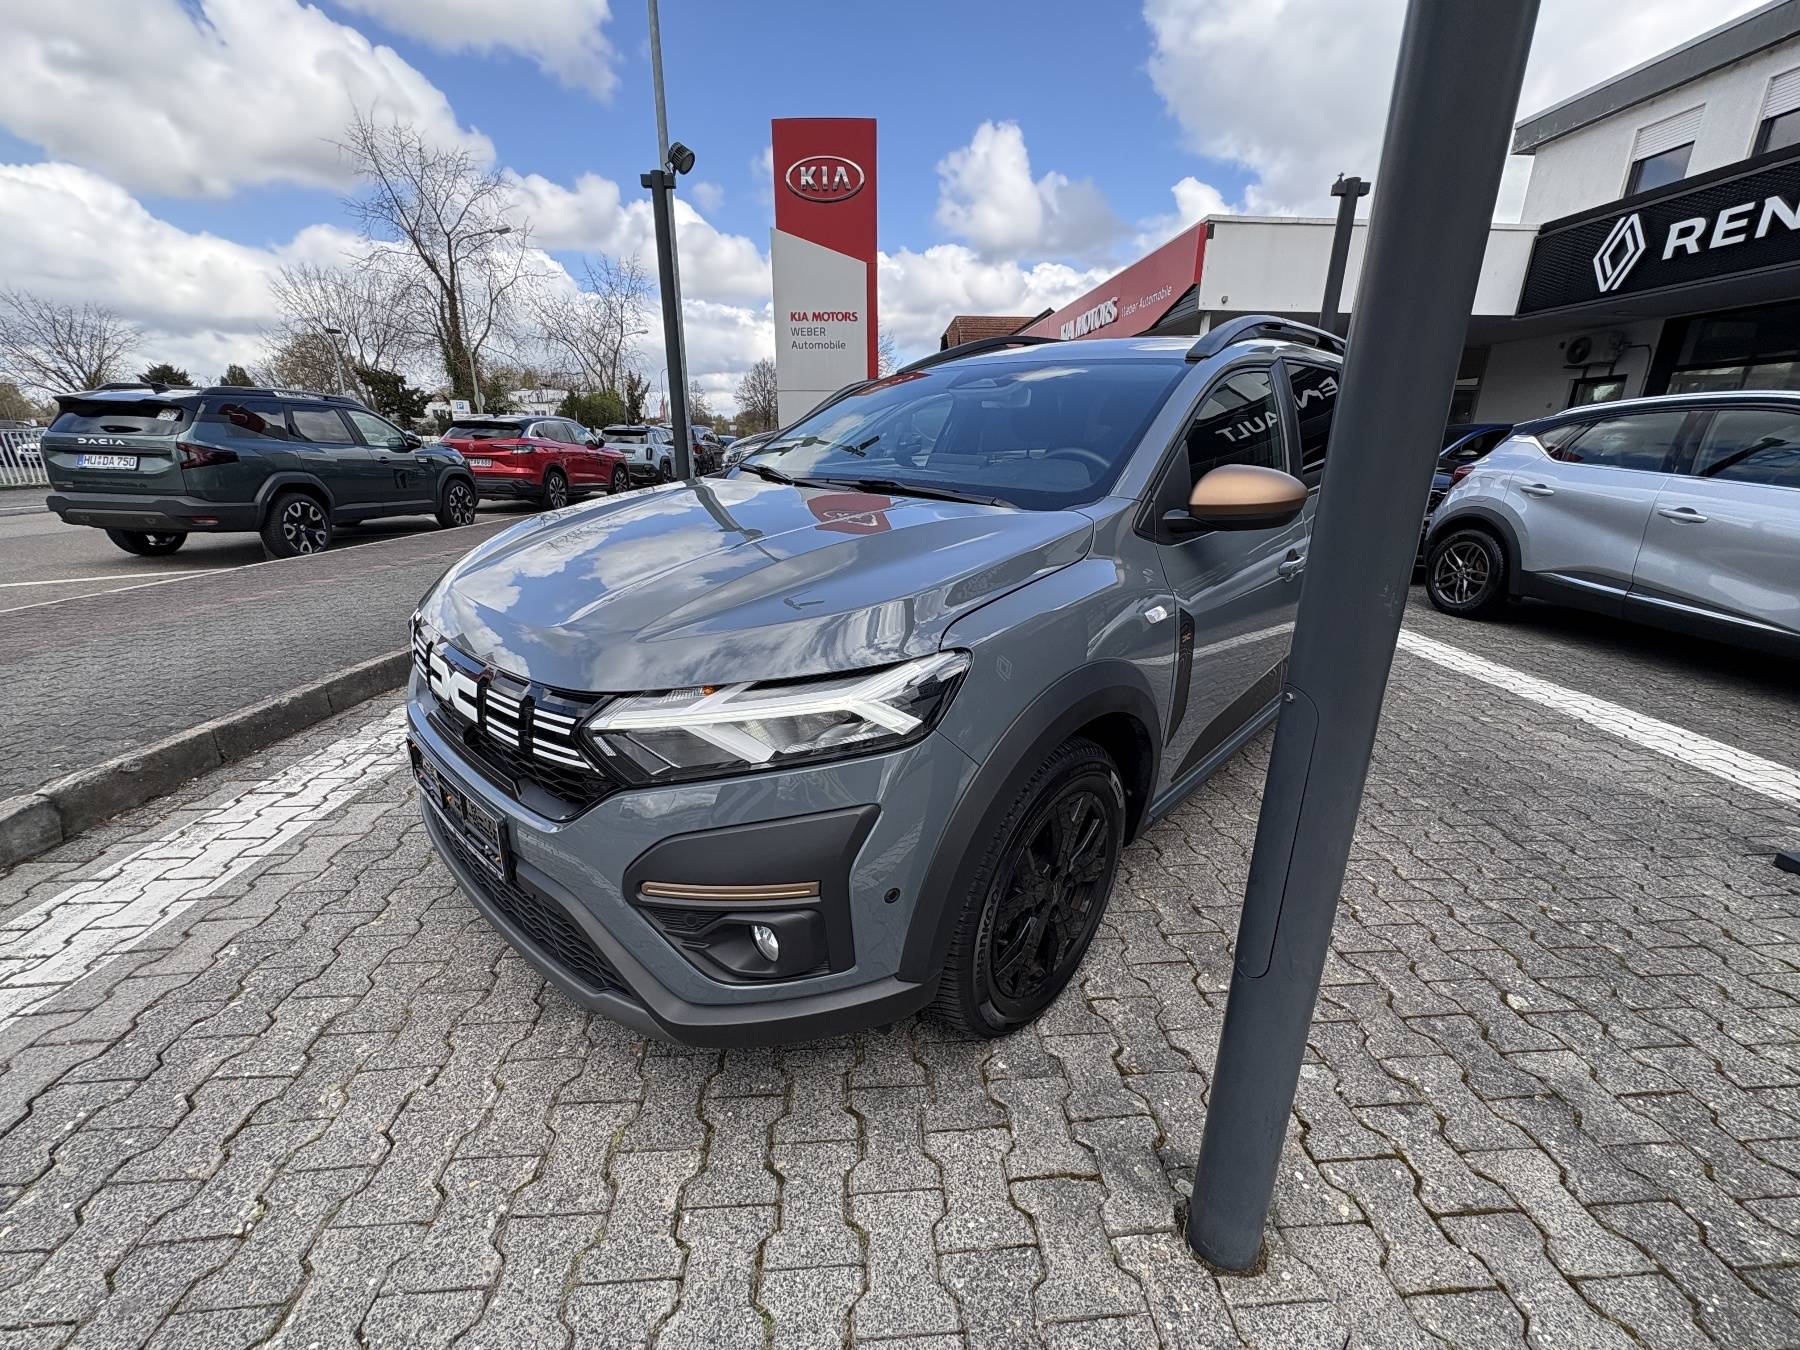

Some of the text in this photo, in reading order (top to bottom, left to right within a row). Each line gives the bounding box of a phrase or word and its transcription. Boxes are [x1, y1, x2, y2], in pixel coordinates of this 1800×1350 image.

[799, 166, 852, 191] KIA
[1661, 195, 1800, 260] REN
[1139, 285, 1173, 309] Automobile
[790, 311, 859, 322] KIA MOTORS
[1075, 296, 1119, 337] MOTORS
[790, 326, 826, 337] WEBER
[791, 340, 847, 350] Automobile
[77, 437, 126, 446] DACIA
[84, 455, 135, 467] HU DA 750
